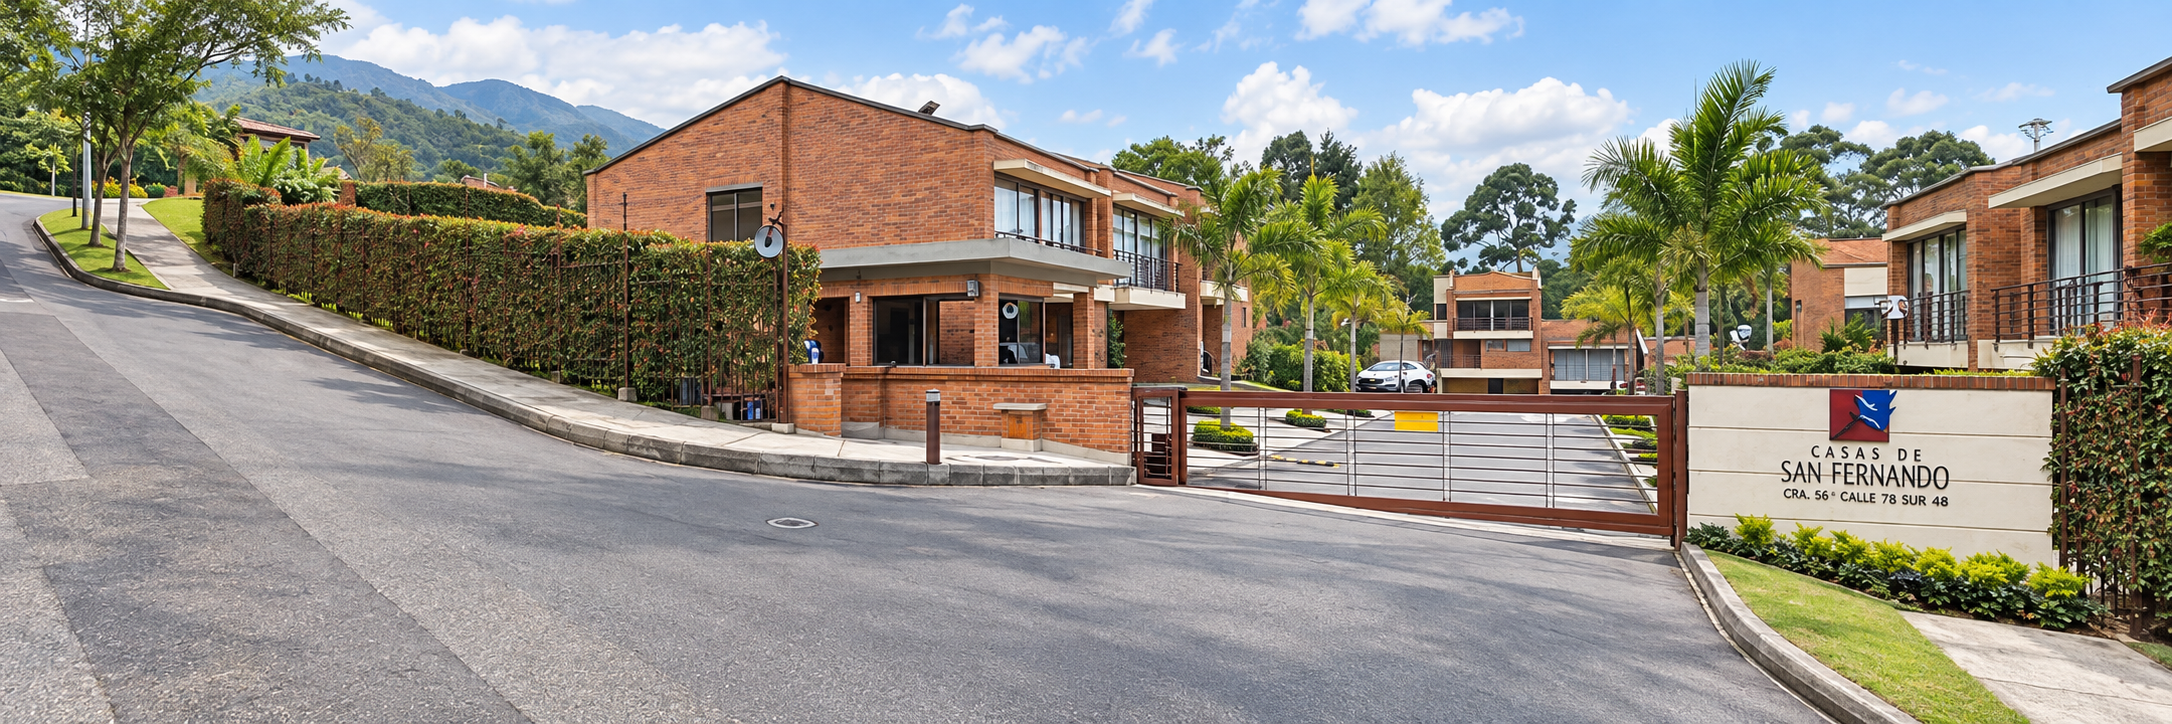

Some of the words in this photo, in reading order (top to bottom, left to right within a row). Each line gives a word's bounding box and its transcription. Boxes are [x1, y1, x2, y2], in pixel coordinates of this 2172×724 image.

[1810, 445, 1880, 461] CASAS
[1897, 448, 1922, 462] DE
[1781, 460, 1822, 484] SAN
[1831, 461, 1950, 490] FERNANDO
[1783, 488, 1810, 500] CRA.
[1840, 491, 1876, 504] CALLE
[1881, 493, 1897, 504] 78
[1902, 494, 1927, 506] SUR
[1932, 495, 1949, 507] 48
